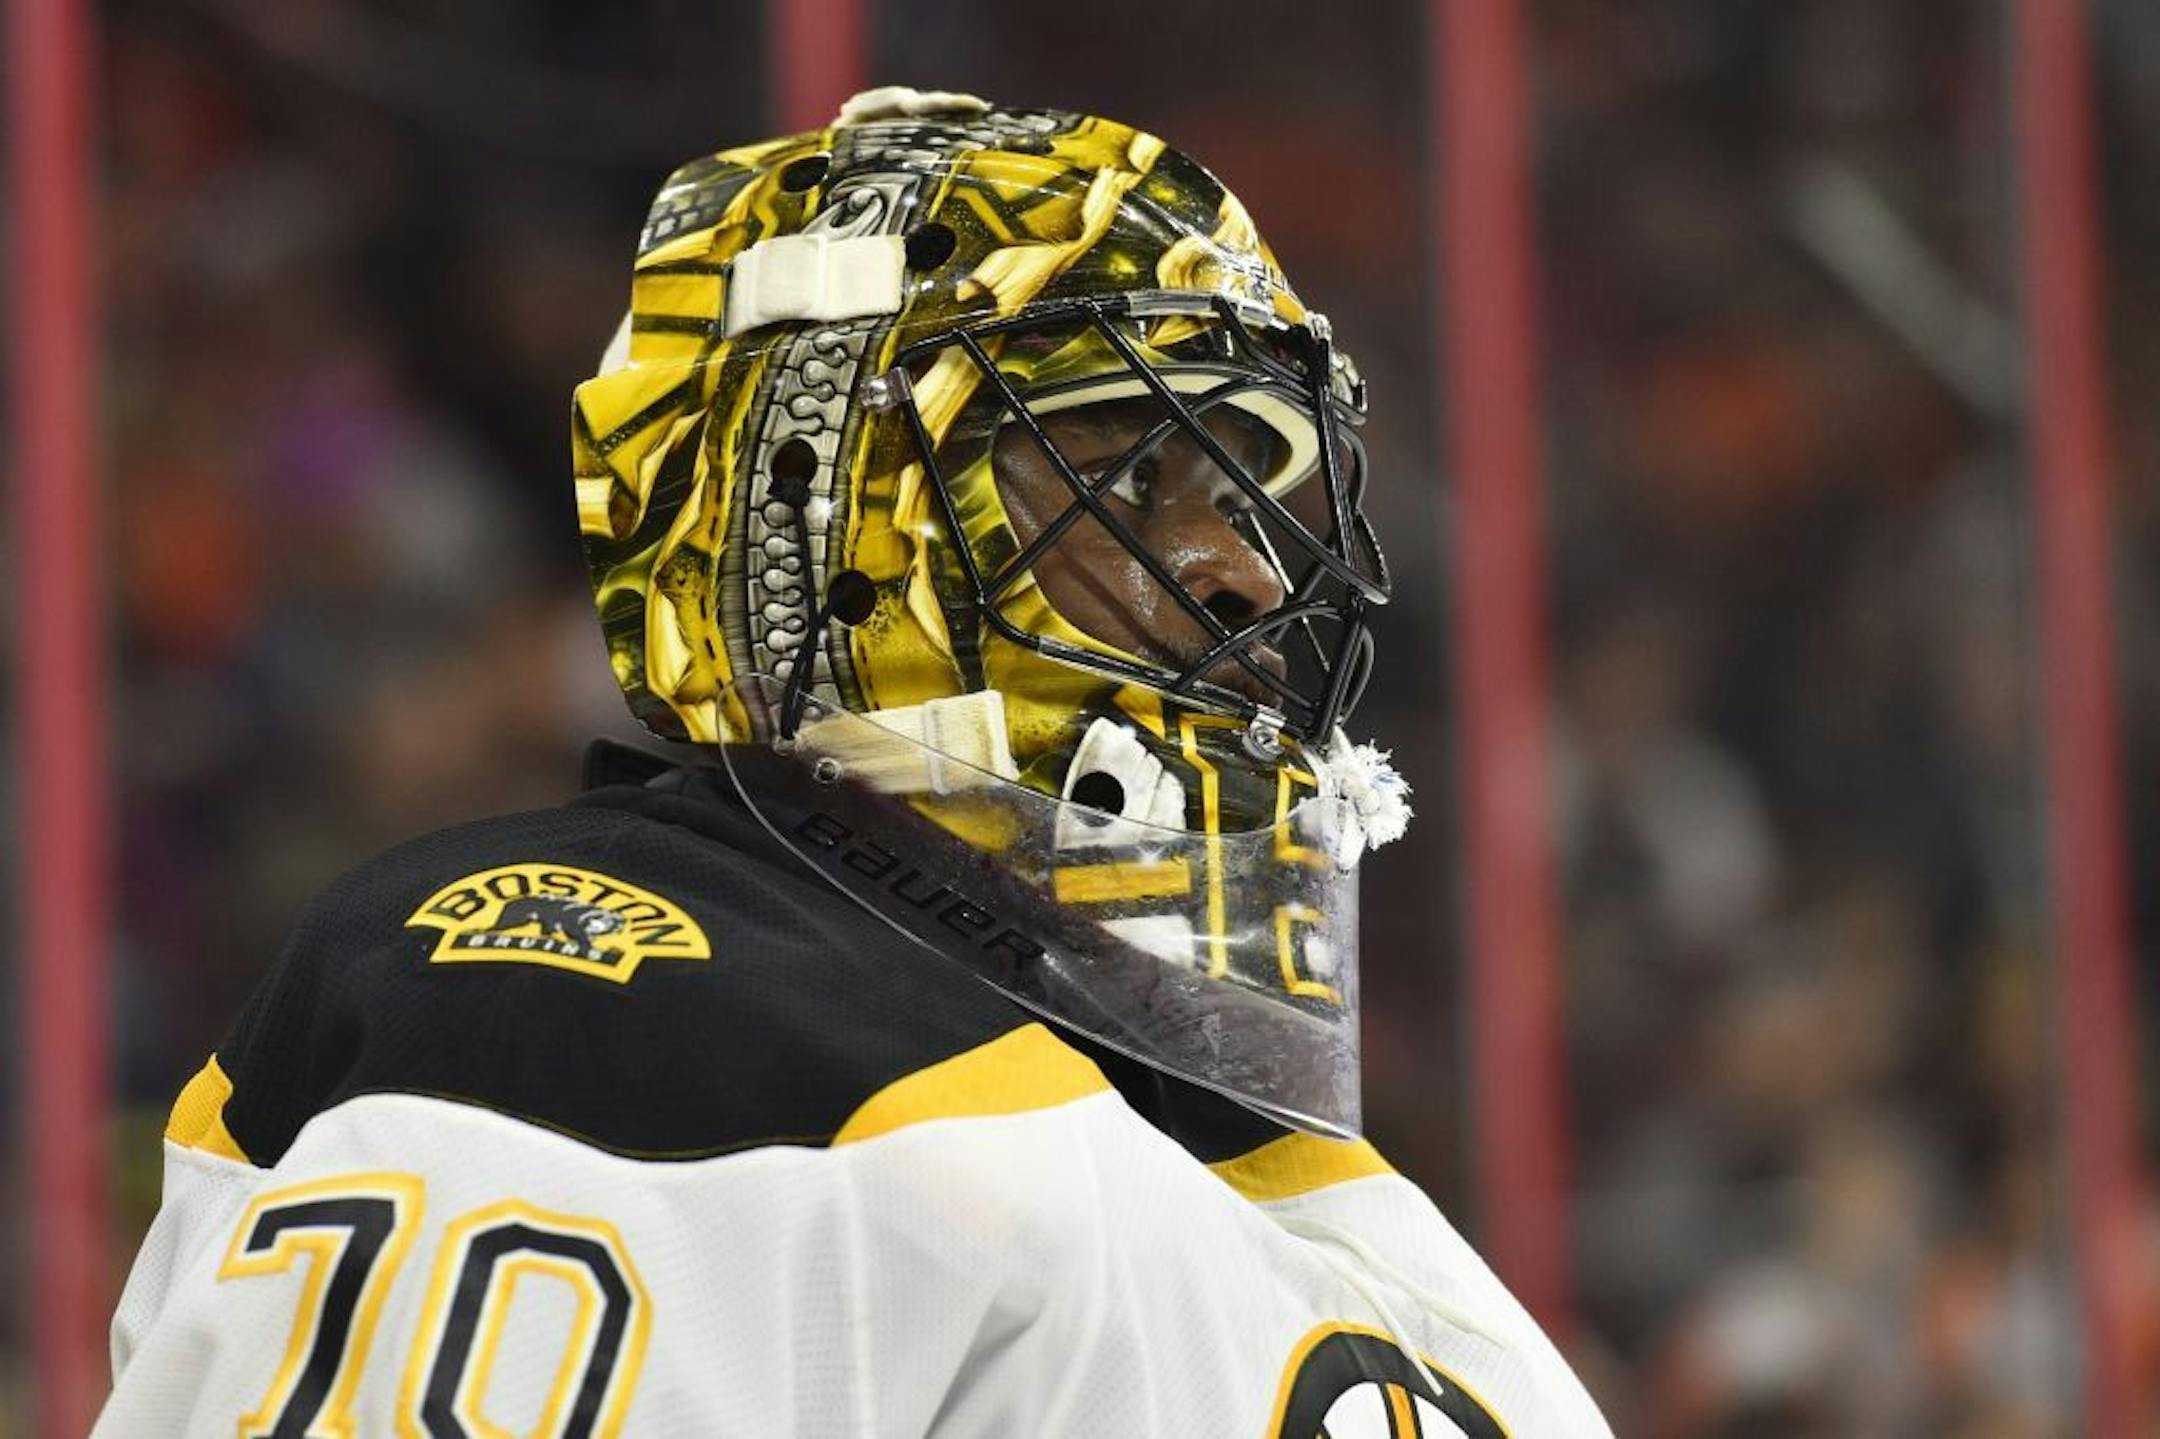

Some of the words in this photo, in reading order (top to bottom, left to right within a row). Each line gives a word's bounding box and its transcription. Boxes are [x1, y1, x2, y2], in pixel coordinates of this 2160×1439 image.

[426, 872, 693, 947] BOSTON
[467, 933, 603, 962] BRUINS
[216, 1170, 655, 1439] 70
